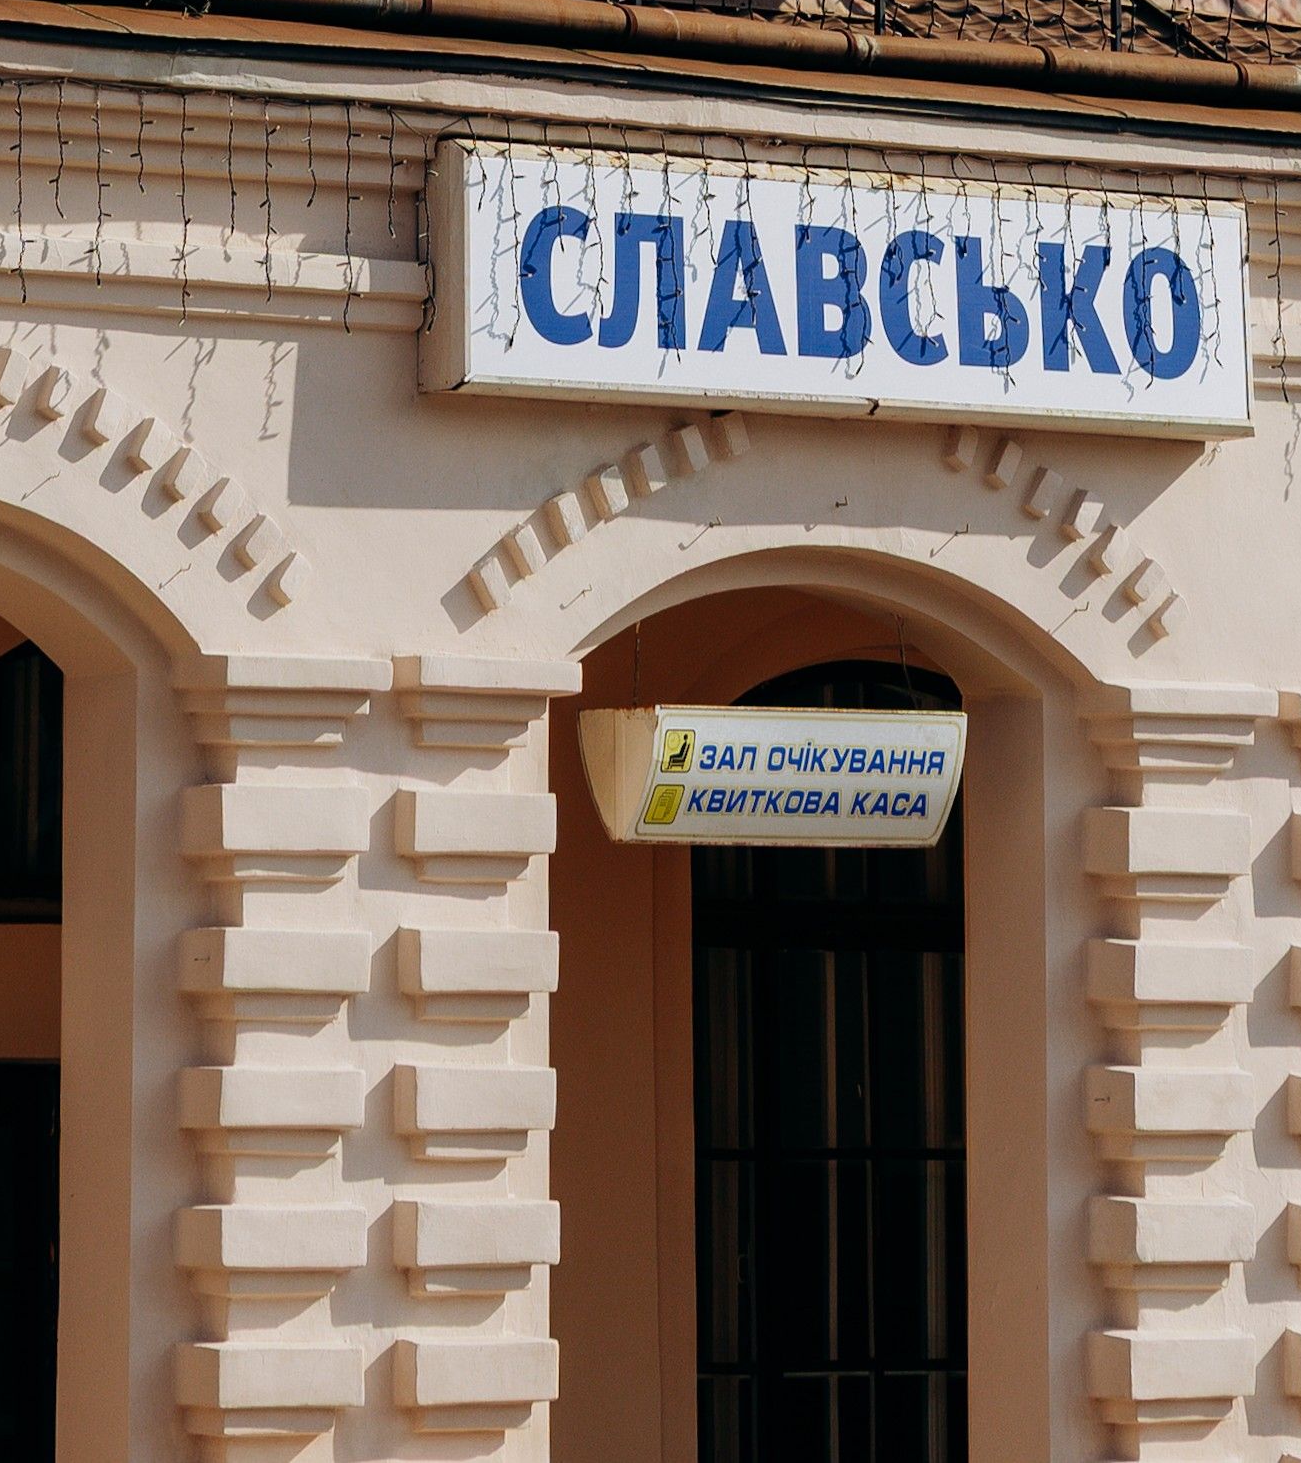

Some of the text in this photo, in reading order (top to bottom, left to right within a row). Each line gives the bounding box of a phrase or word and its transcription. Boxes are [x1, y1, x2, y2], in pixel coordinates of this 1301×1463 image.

[520, 205, 1201, 380] СЛАВСЬКО
[698, 744, 758, 772] ЗАЛ
[687, 788, 928, 818] КВИТКОВА КАСА
